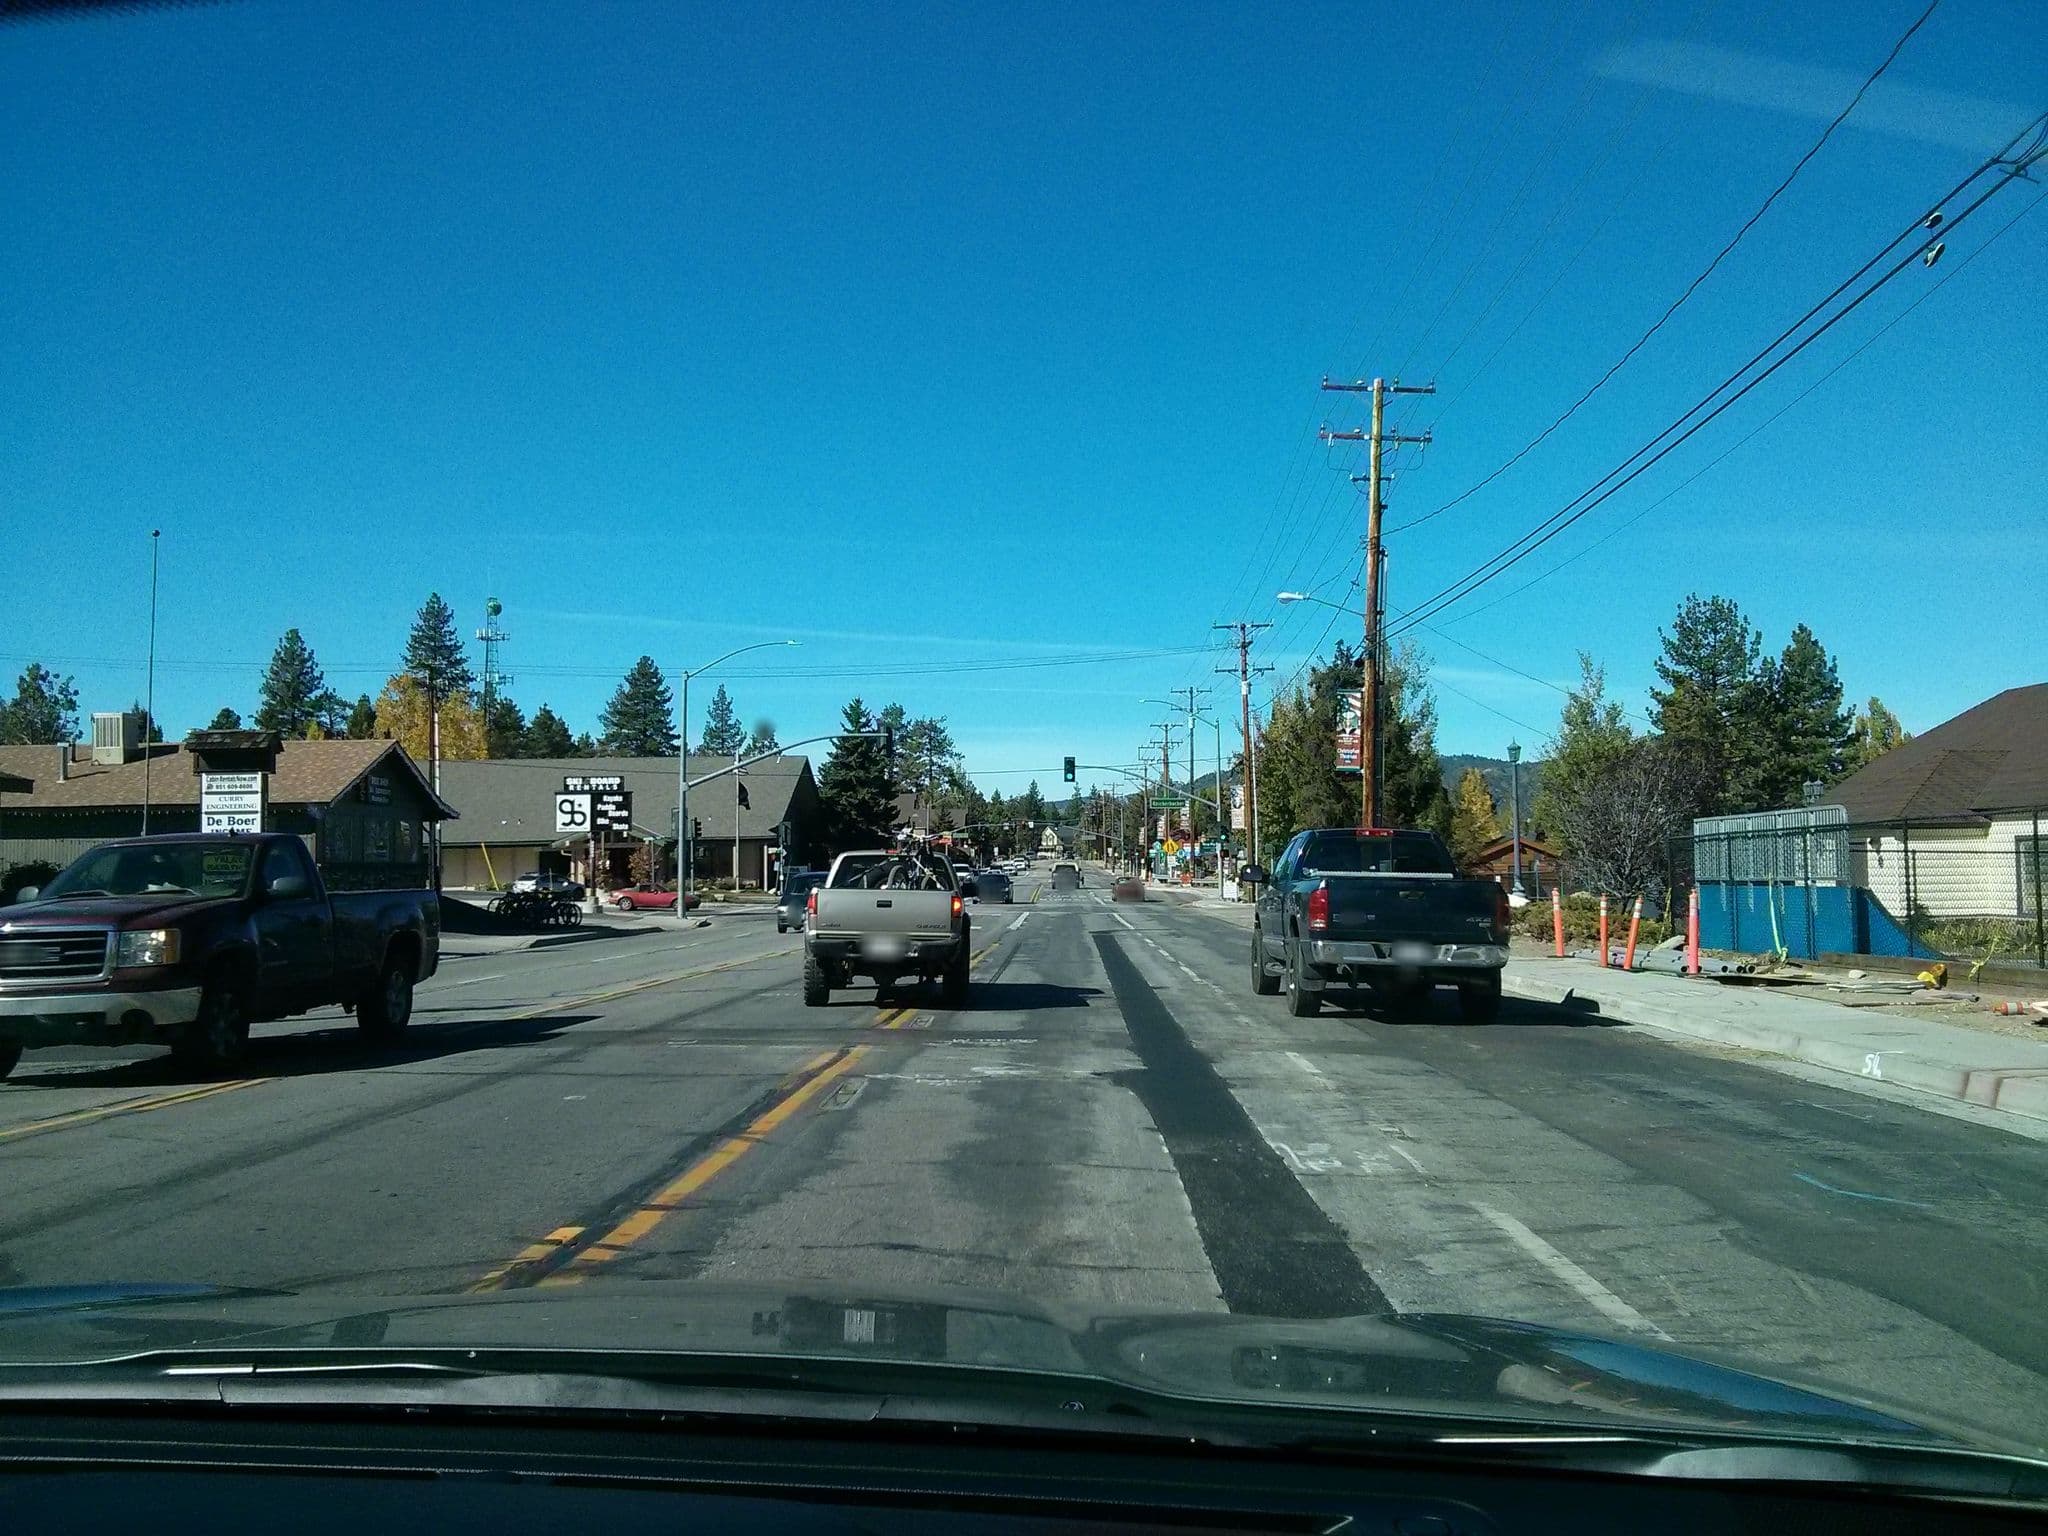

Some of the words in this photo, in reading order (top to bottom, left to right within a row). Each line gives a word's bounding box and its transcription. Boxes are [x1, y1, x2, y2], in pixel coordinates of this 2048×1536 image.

[565, 777, 583, 785] SKI
[590, 777, 621, 785] BOARD
[207, 816, 222, 826] De
[227, 816, 257, 826] Boer
